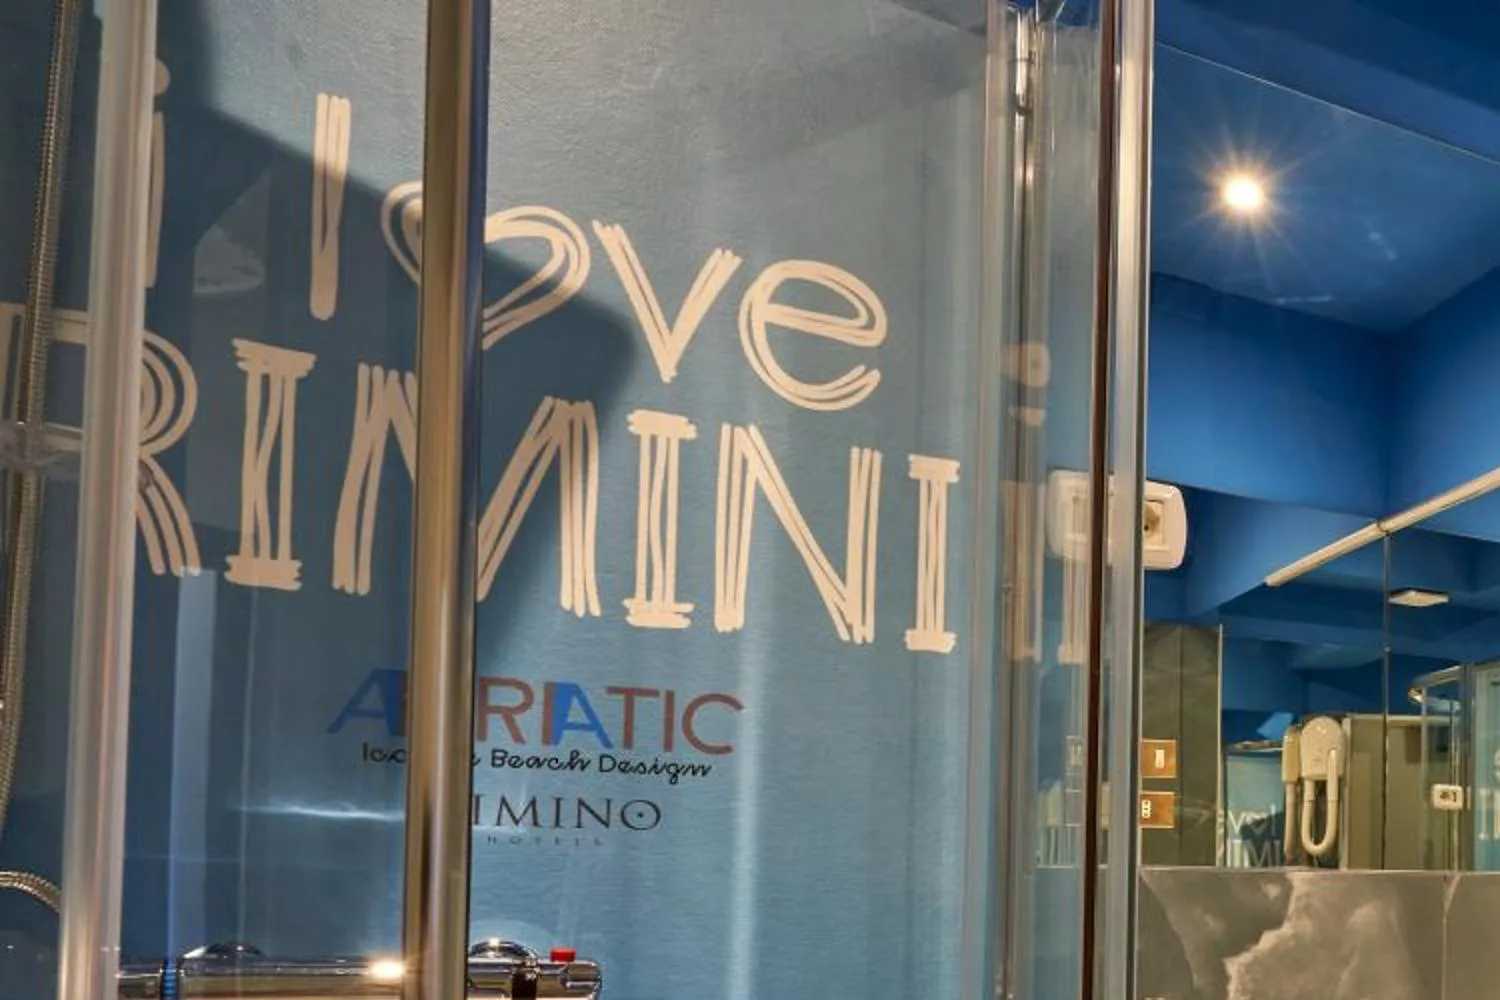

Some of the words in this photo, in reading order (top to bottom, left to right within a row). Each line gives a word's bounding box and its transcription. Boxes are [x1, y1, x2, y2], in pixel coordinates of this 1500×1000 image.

[0, 303, 960, 652] RIMINI
[327, 668, 745, 756] ARIATIC
[491, 748, 592, 773] Beach
[599, 754, 713, 786] Design
[472, 793, 662, 832] IMINO
